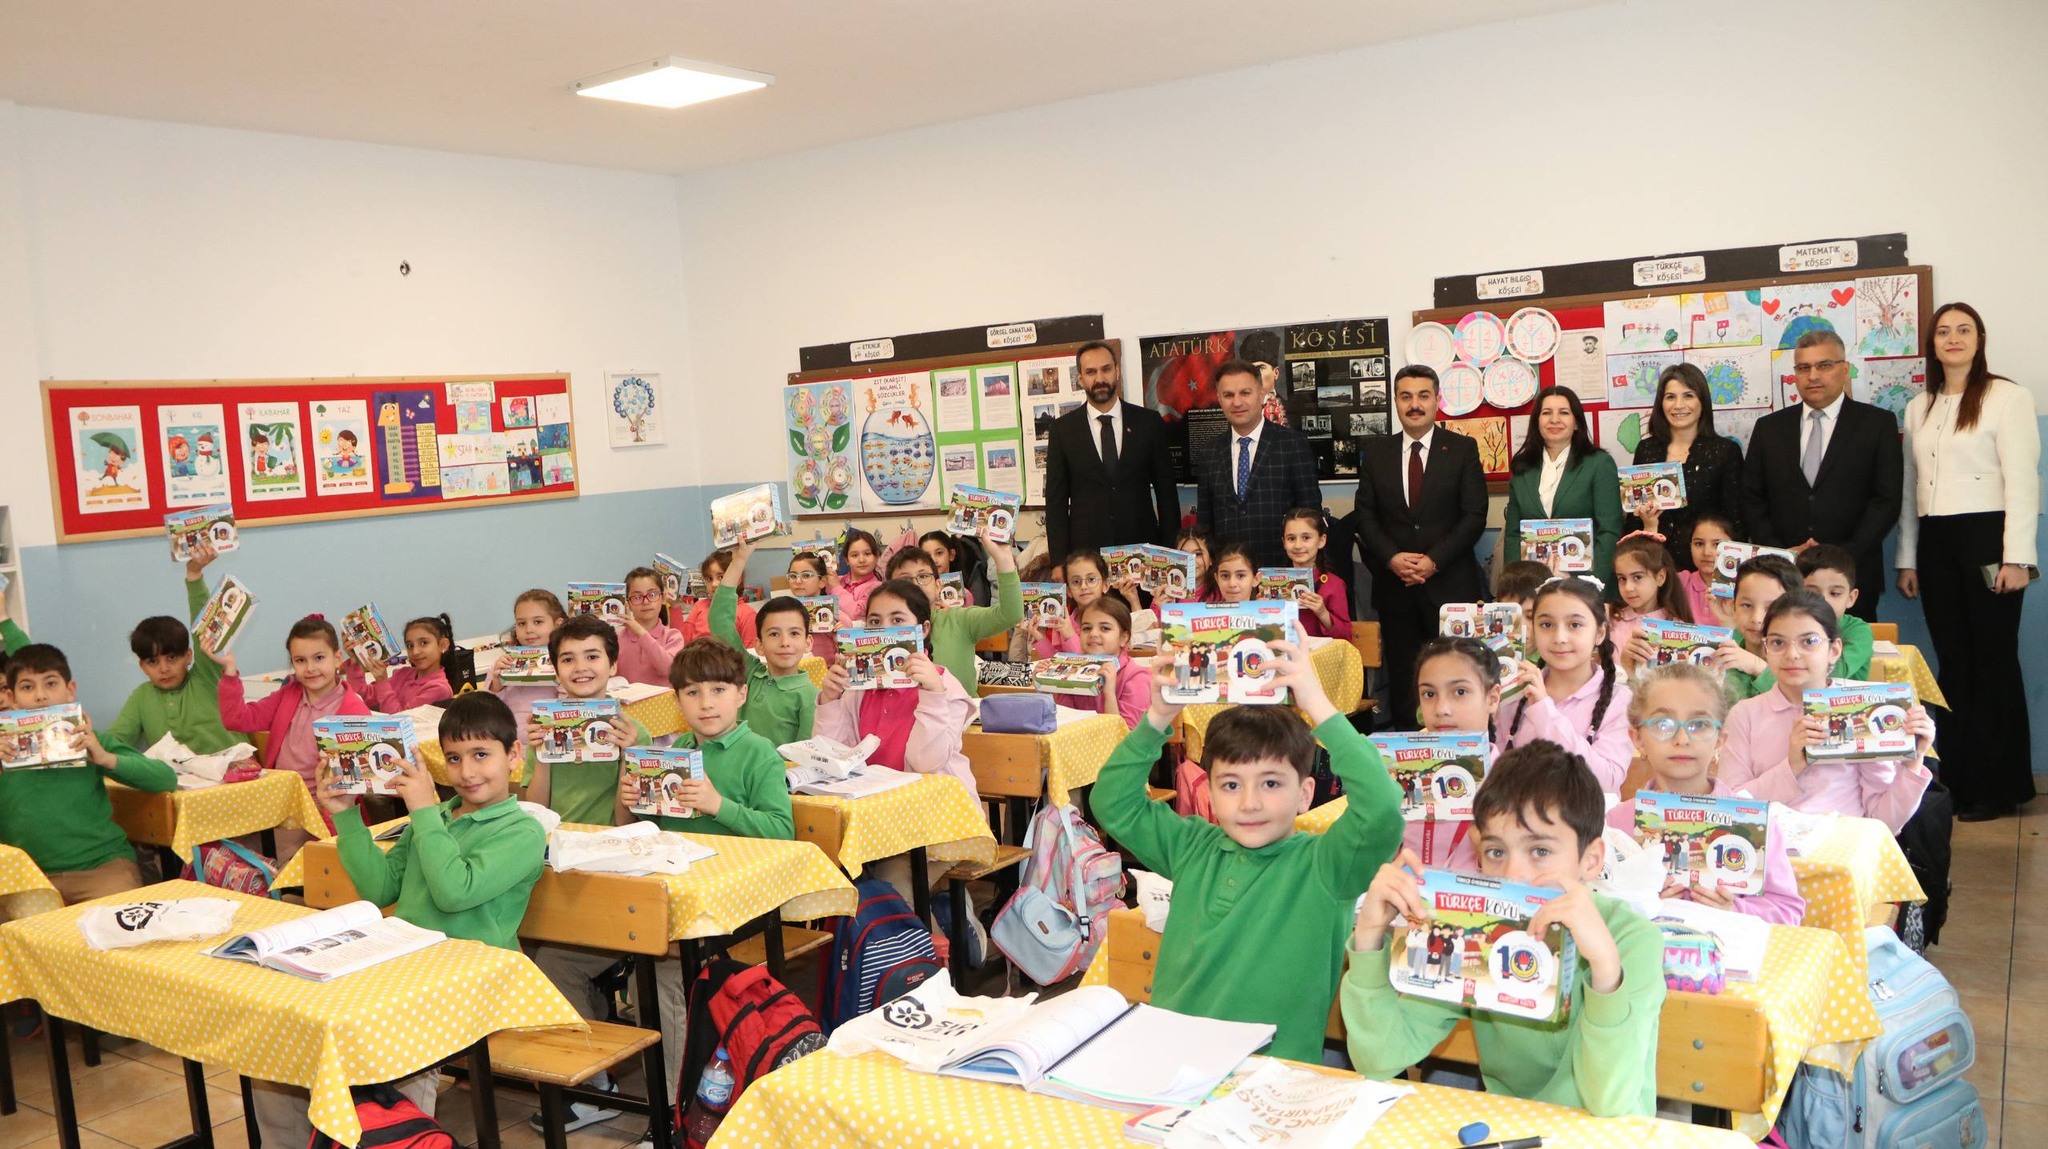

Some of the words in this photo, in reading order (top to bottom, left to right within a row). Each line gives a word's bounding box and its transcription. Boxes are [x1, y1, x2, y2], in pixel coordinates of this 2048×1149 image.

[1656, 261, 1682, 270] TÜRKÇE
[1805, 258, 1832, 267] KÖŞESİ
[1488, 277, 1509, 285] HAYAT
[1510, 274, 1531, 283] BİLGİSİ
[1657, 272, 1682, 282] KÖŞESİ
[1499, 286, 1522, 295] KÖŞESİ
[1150, 335, 1229, 359] ATATÜRK
[1293, 327, 1376, 350] KÖŞESİ
[337, 406, 352, 414] YAZ
[1193, 616, 1228, 630] TÜRKÇE
[1664, 630, 1688, 641] TÜRKÇE
[1831, 695, 1861, 707] TÜRKÇE
[337, 732, 362, 743] TÜRKÇE
[1397, 749, 1430, 760] TÜRKÇE
[1666, 809, 1702, 824] TÜRKÇE
[1438, 893, 1482, 912] TÜRKÇE
